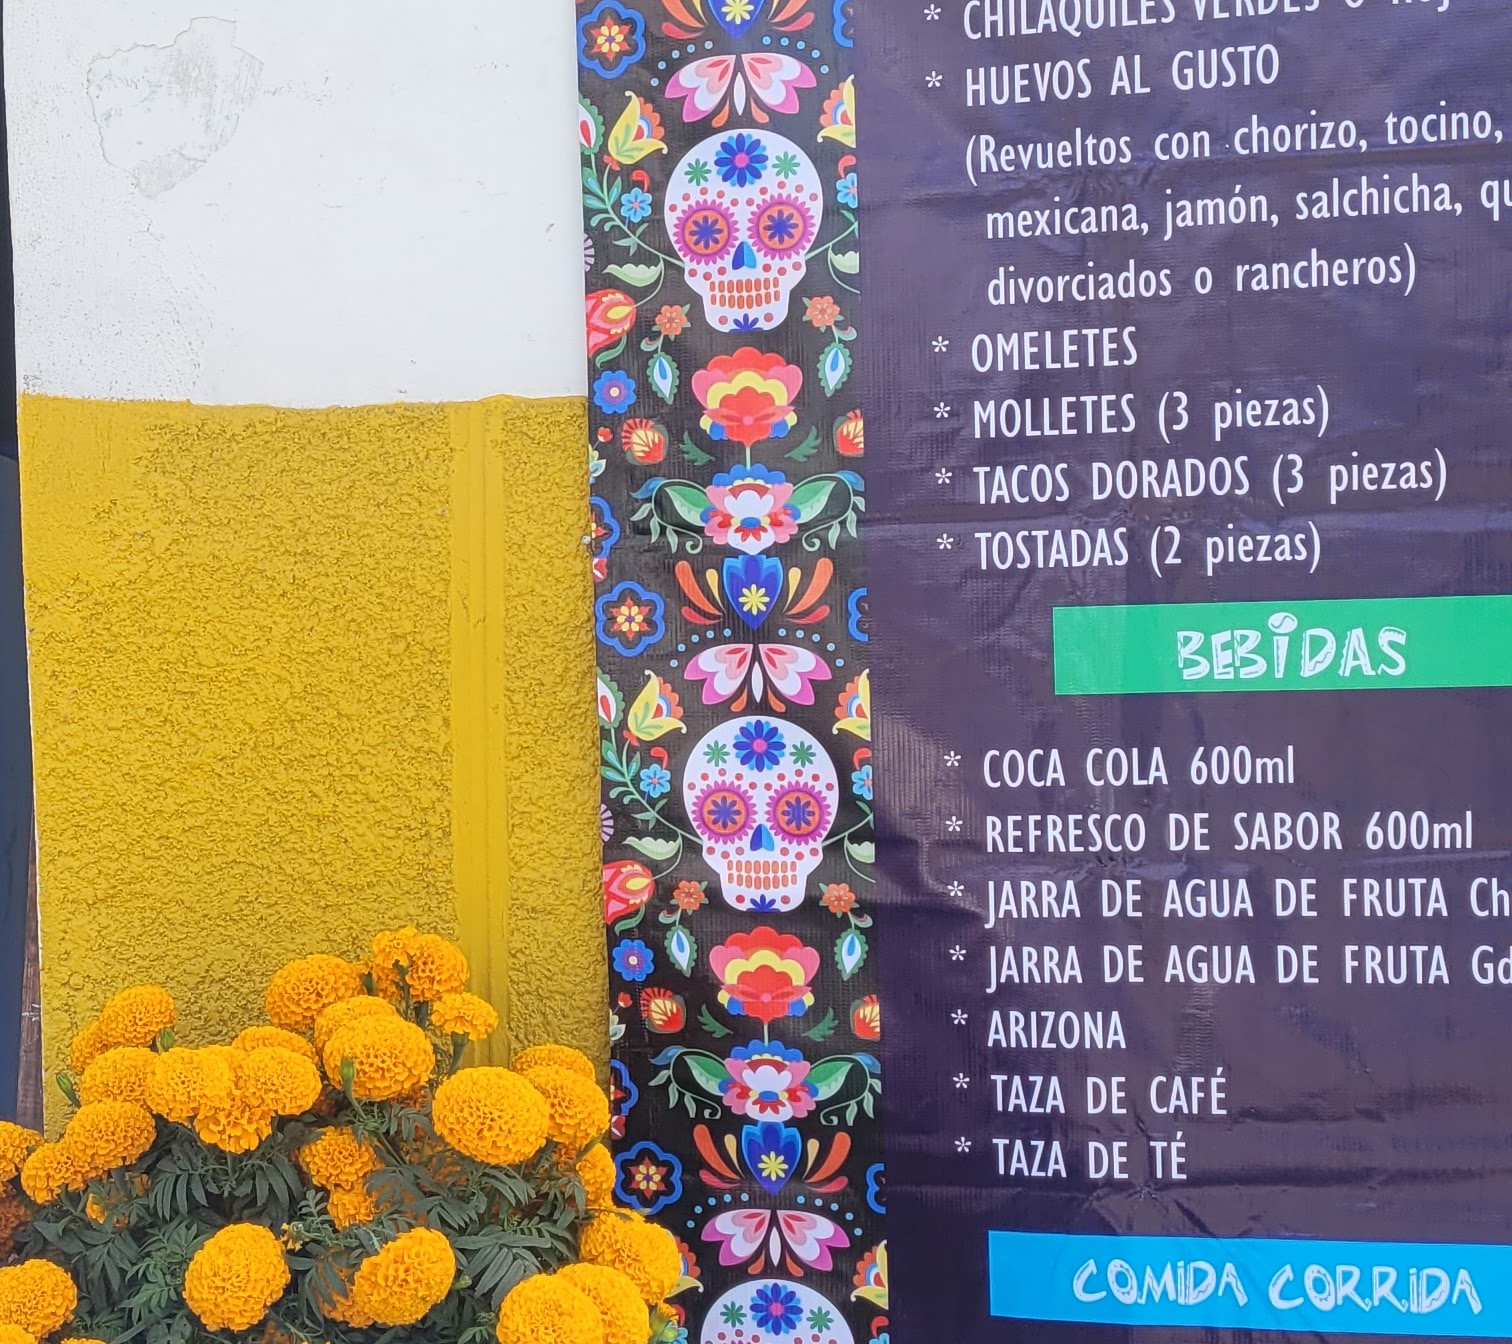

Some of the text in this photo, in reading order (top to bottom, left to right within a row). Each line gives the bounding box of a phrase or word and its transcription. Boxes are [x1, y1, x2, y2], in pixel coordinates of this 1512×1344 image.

[966, 43, 1280, 107] HUEVOS AL GUSTO
[965, 100, 1504, 187] (Revueltos con chorizo, tocino,
[986, 197, 1149, 239] mexicana,
[1163, 184, 1279, 242] jamón,
[1295, 172, 1463, 221] salchicha,
[987, 242, 1416, 306] divorciados o rancheros)
[971, 325, 1138, 373] OMELETES
[973, 384, 1329, 445] MOLLETES (3 piezas)
[972, 447, 1447, 507] TACOS DORADOS (3 piezas)
[974, 520, 1321, 579] TOSTADAS (2 piezas)
[983, 744, 1295, 789] COCA COLA 600ml
[986, 810, 1473, 853] REFRESCO DE SABOR 600ml
[983, 879, 1081, 929] JARRA
[1101, 879, 1143, 918] DE
[1163, 878, 1254, 918] AGUA
[1274, 878, 1318, 917] DE
[1343, 877, 1449, 918] FRUTA
[985, 945, 1083, 994] JARRA
[1103, 944, 1145, 983] DE
[1164, 944, 1256, 985] AGUA
[1276, 944, 1320, 984] DE
[1344, 944, 1450, 985] FRUTA
[987, 1010, 1127, 1049] ARIZONA
[990, 1066, 1228, 1115] TAZA DE CAFÉ
[992, 1130, 1187, 1180] TAZA DE TÉ
